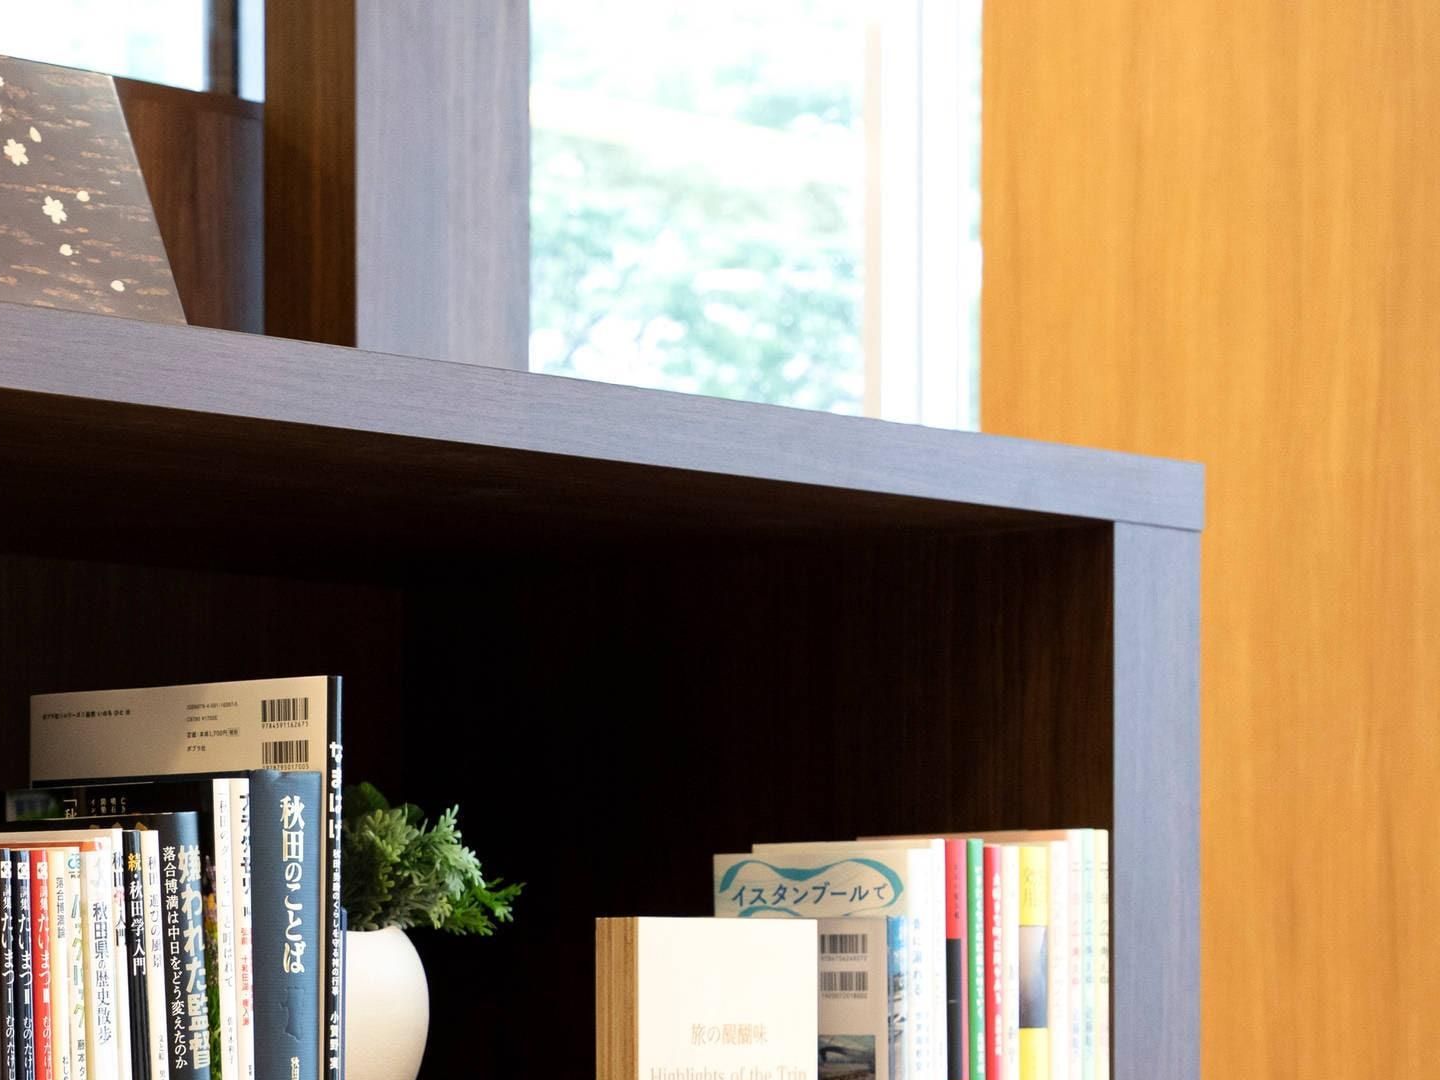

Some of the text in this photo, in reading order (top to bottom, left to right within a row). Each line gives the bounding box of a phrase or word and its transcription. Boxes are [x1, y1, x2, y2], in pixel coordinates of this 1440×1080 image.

[127, 852, 147, 977] 続・秋田学入門
[279, 795, 306, 974] 秋田のことば
[732, 881, 888, 907] イスタンブールで
[92, 901, 113, 1046] 秋田県の歴史散歩
[162, 846, 189, 1070] 落合博満は中日をどう変えたのか
[177, 845, 211, 1070] 嫌われた監督
[690, 1023, 768, 1046] 旅の醍醐味
